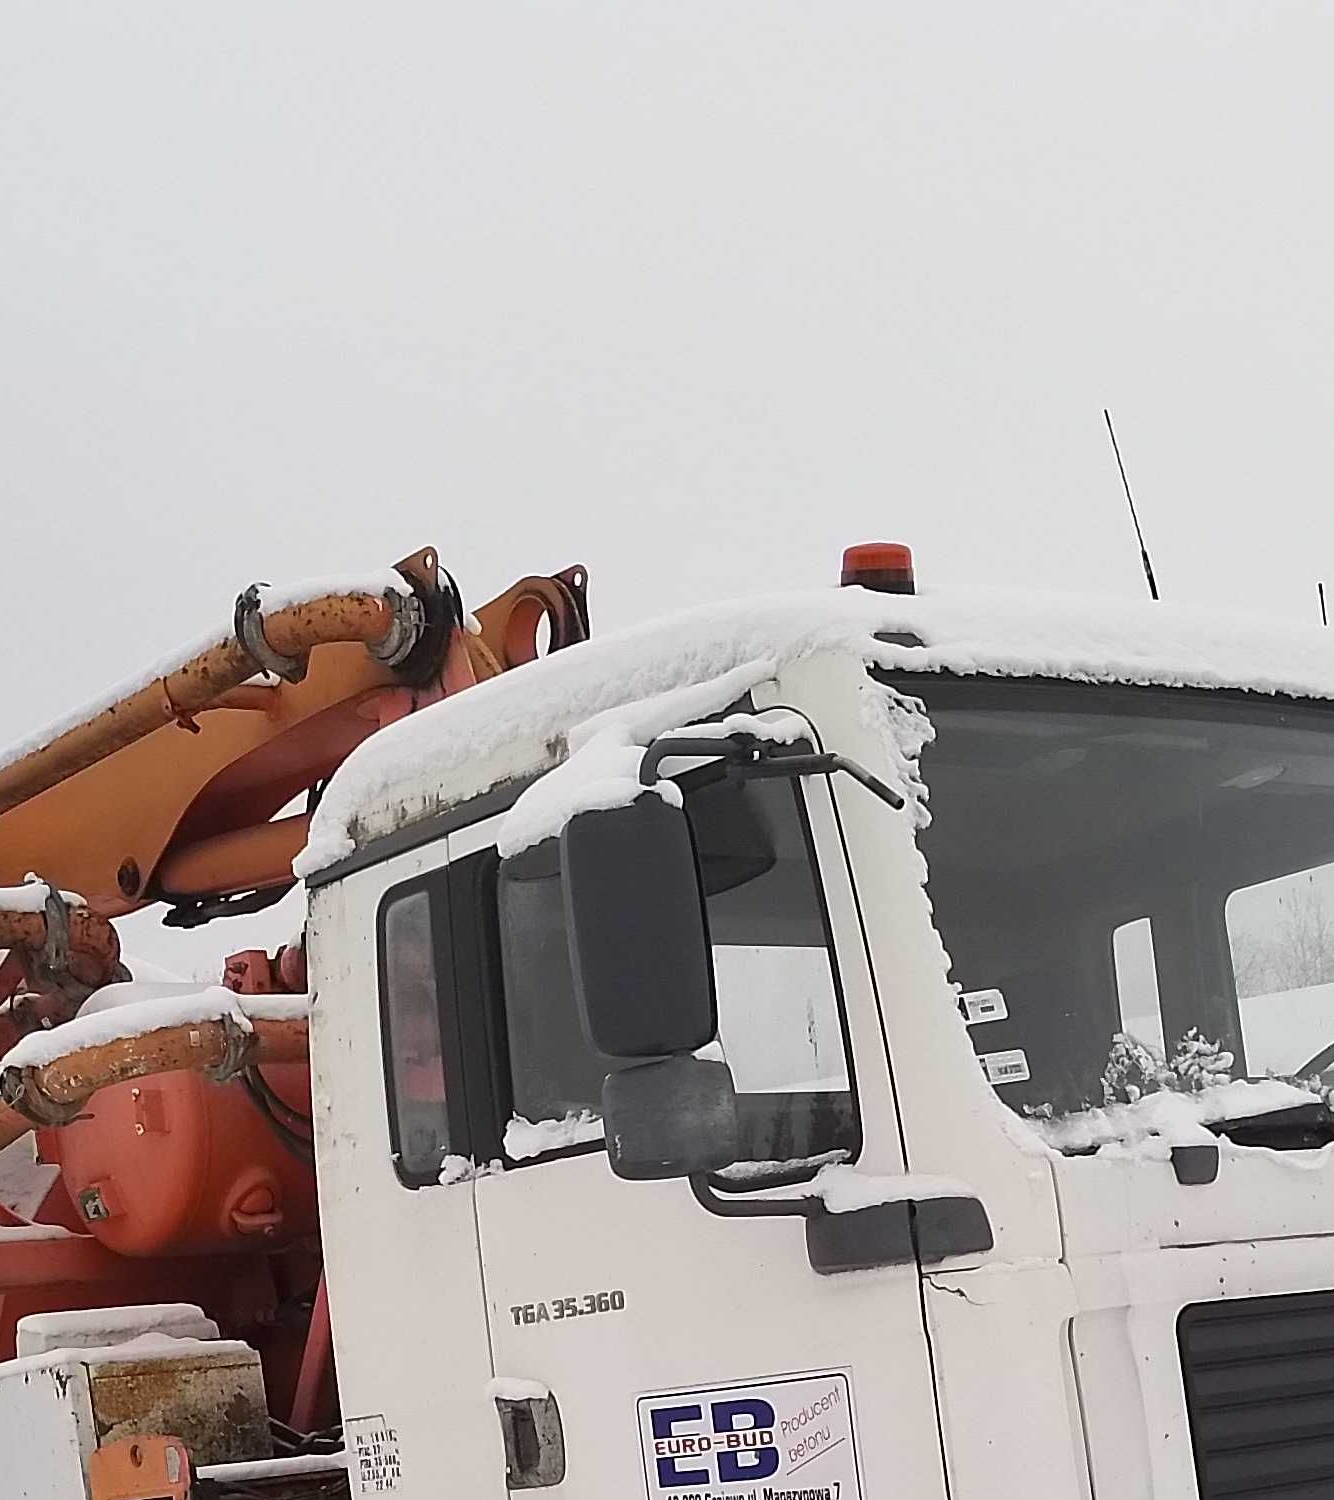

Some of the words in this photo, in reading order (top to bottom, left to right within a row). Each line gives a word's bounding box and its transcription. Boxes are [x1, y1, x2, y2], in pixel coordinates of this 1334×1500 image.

[510, 1302, 550, 1325] TGA
[551, 1290, 625, 1320] 35.360
[780, 1386, 841, 1437] Producent
[654, 1430, 774, 1456] EURO-BUD
[788, 1425, 832, 1463] betonu
[832, 1481, 841, 1500] 7
